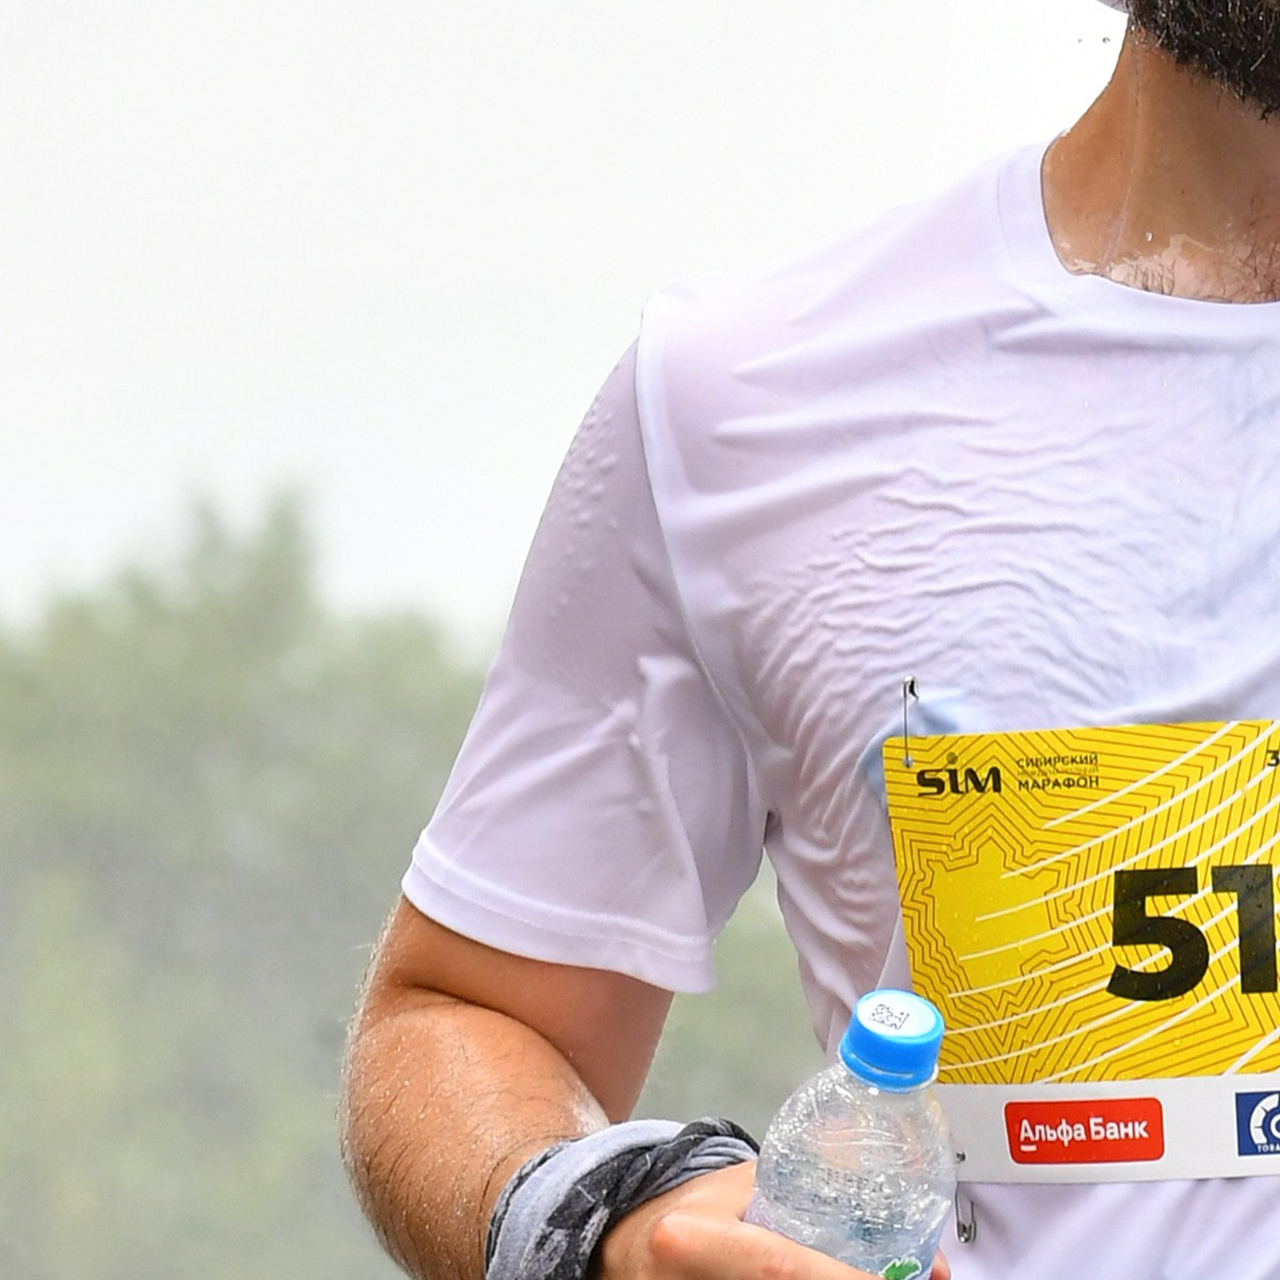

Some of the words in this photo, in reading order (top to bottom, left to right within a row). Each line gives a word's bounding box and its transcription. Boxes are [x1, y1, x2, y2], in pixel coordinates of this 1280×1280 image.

[1017, 752, 1098, 768] СИБИРСКИЙ
[1266, 749, 1280, 767] 3
[1018, 776, 1099, 792] МАРАФОН
[1105, 863, 1278, 1002] 51
[1020, 1118, 1086, 1150] Альфа
[1089, 1117, 1149, 1141] Банк
